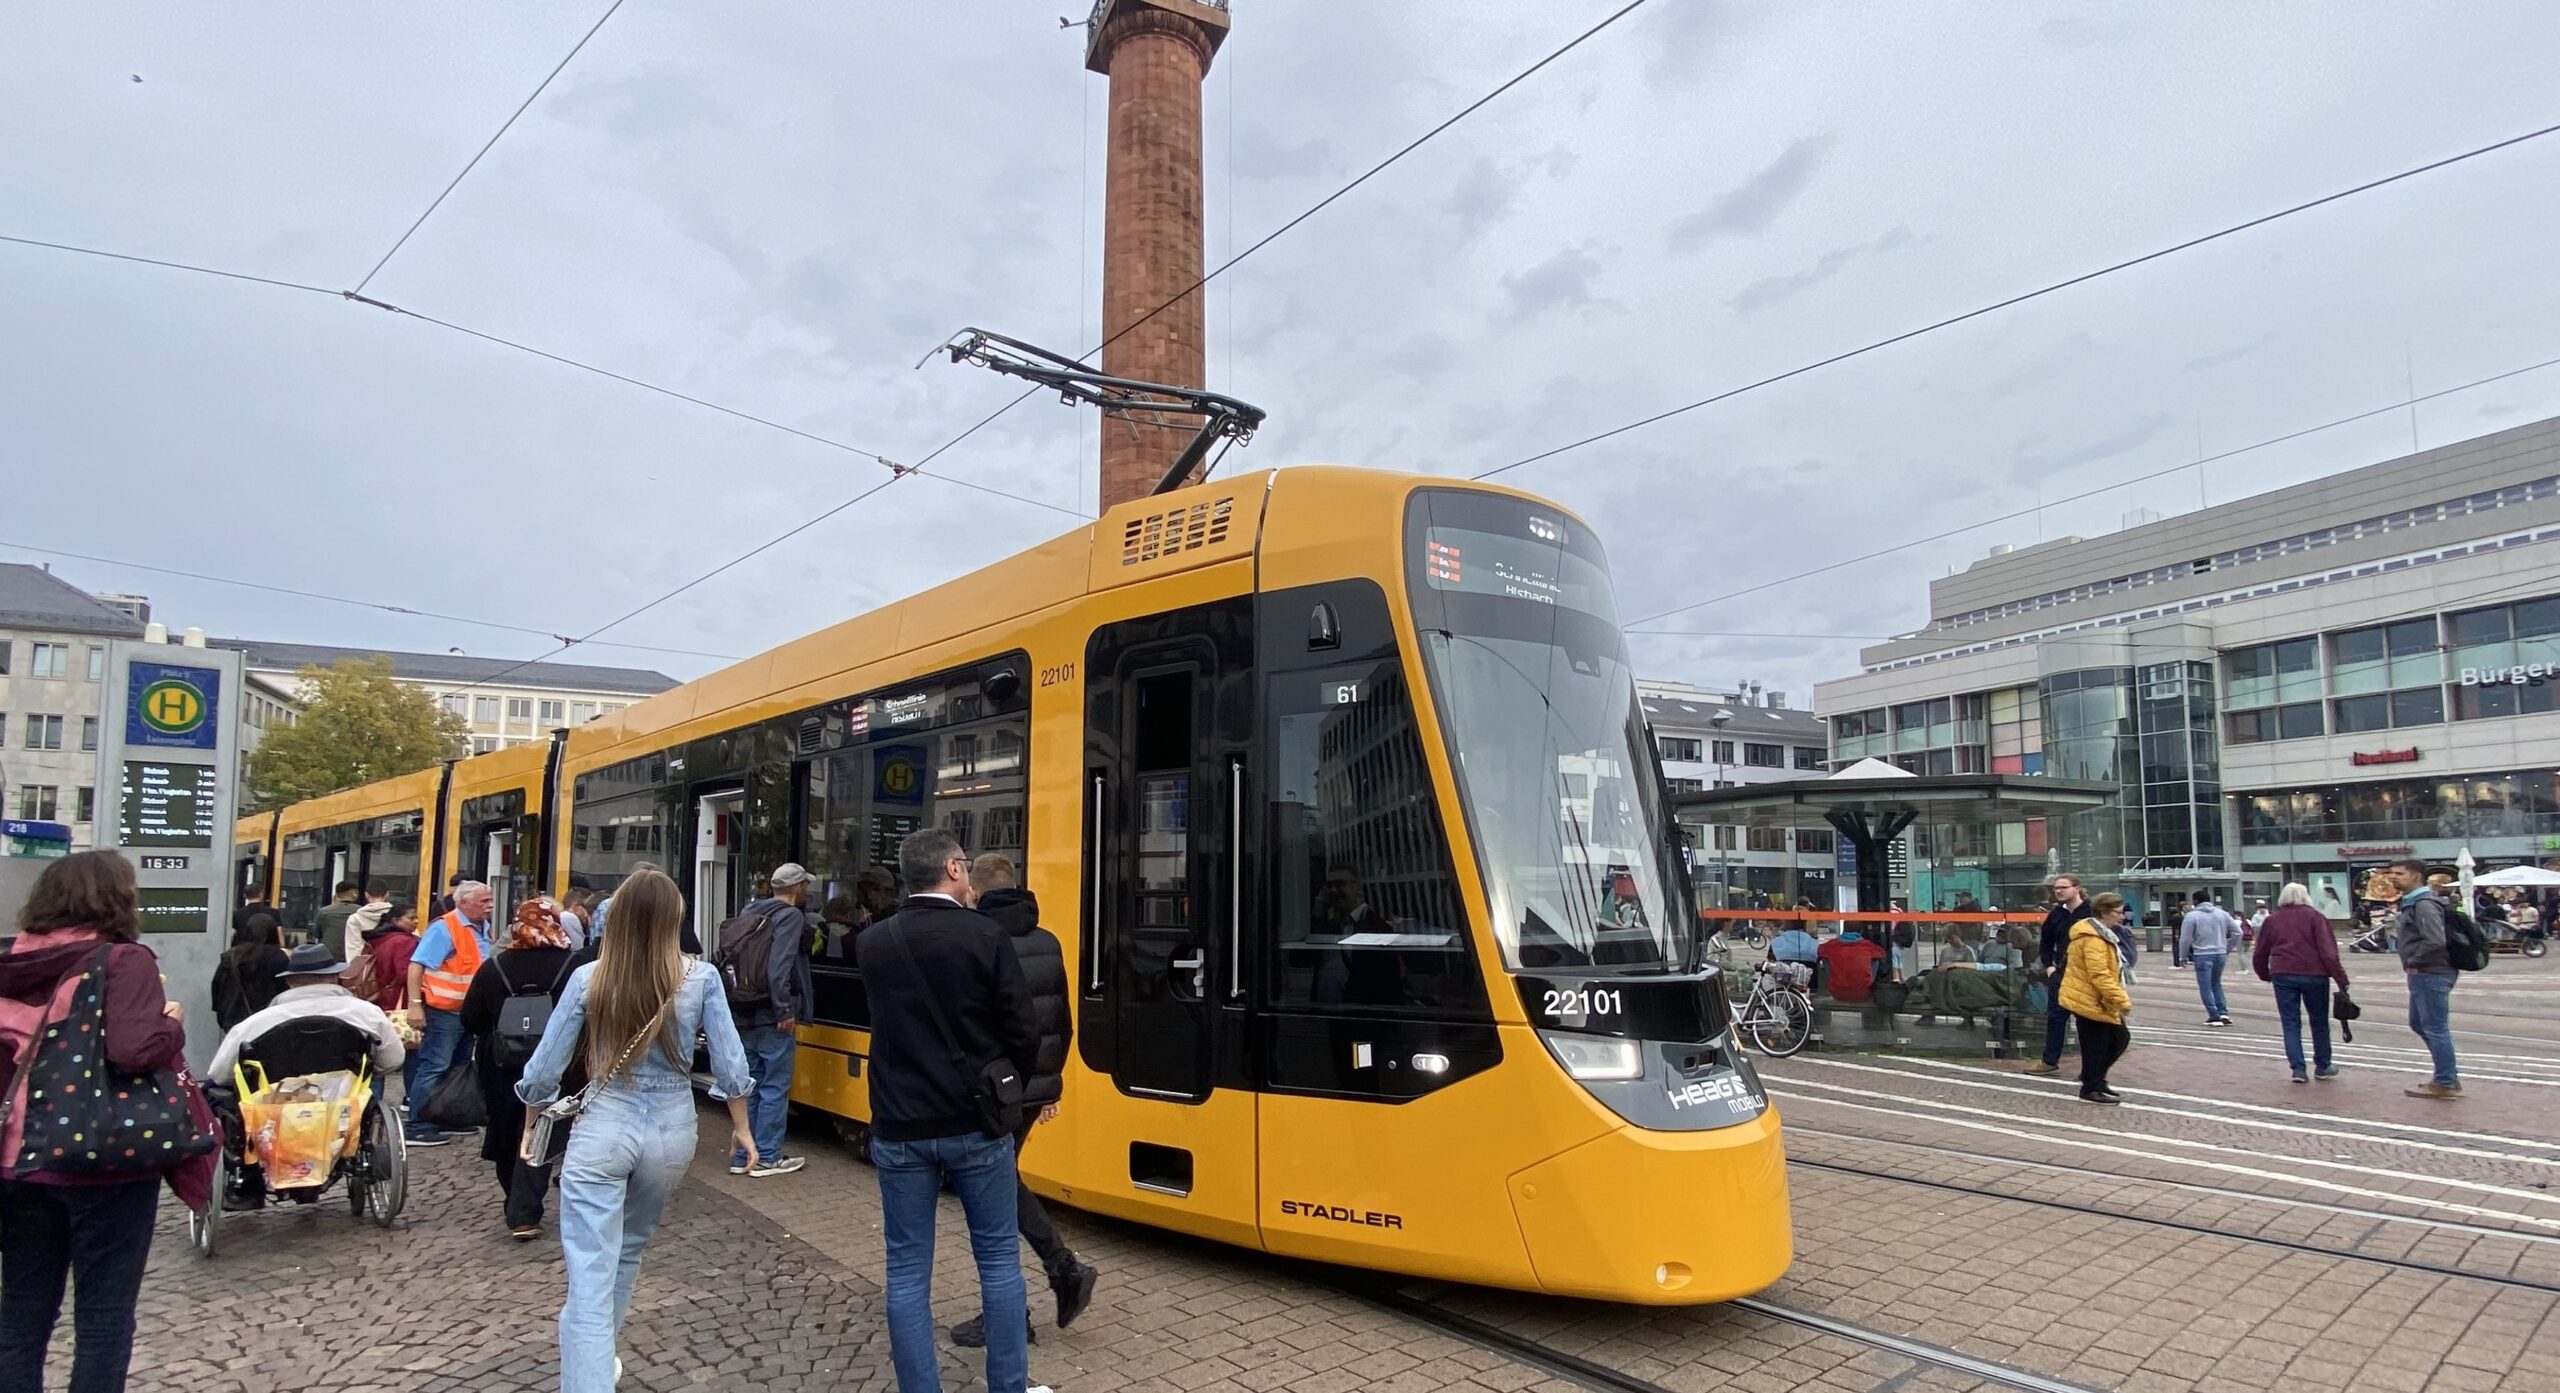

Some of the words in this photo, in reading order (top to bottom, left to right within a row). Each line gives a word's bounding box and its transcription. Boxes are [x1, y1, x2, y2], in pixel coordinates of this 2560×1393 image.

[1041, 662, 1075, 687] 22101
[160, 692, 187, 722] H
[1337, 685, 1357, 704] 61
[8, 823, 27, 833] 218
[147, 859, 184, 868] 16:33
[1543, 990, 1622, 1015] 22101
[1281, 1200, 1402, 1230] STADLER
